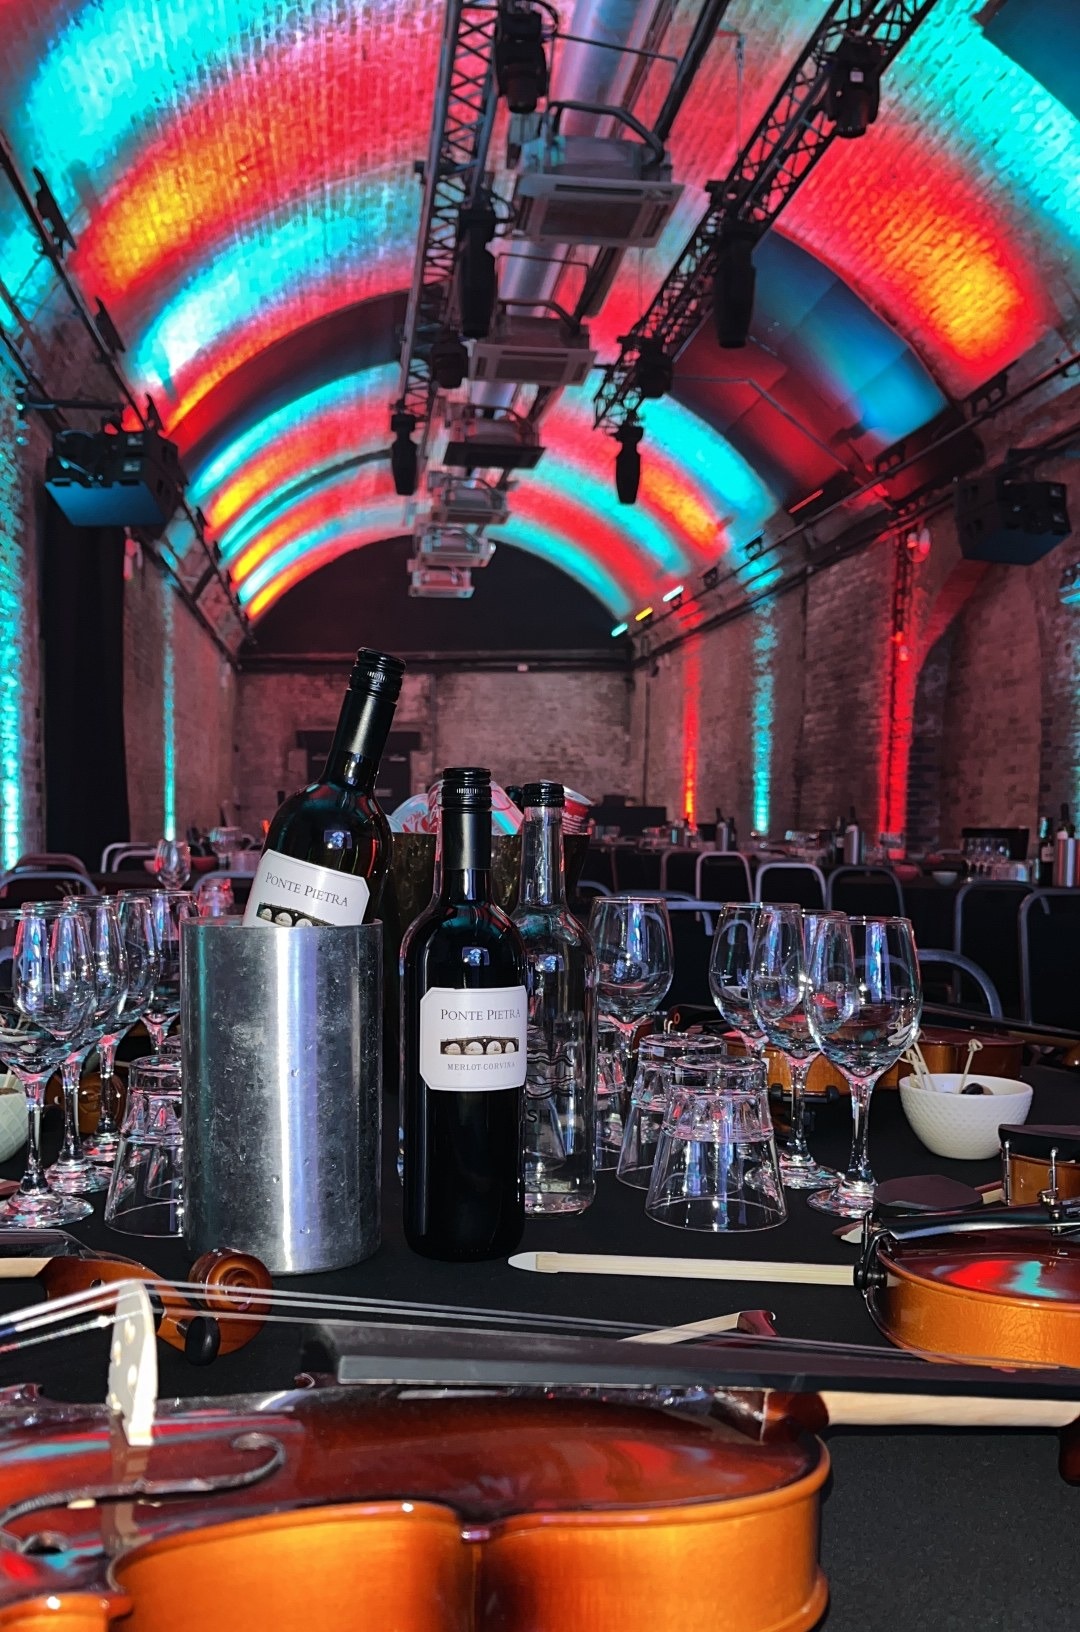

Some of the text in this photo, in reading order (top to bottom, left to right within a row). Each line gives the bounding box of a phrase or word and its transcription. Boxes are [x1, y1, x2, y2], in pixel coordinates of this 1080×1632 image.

[265, 871, 349, 908] PONTE PIETRA
[441, 1008, 521, 1021] PONTE PIETRA
